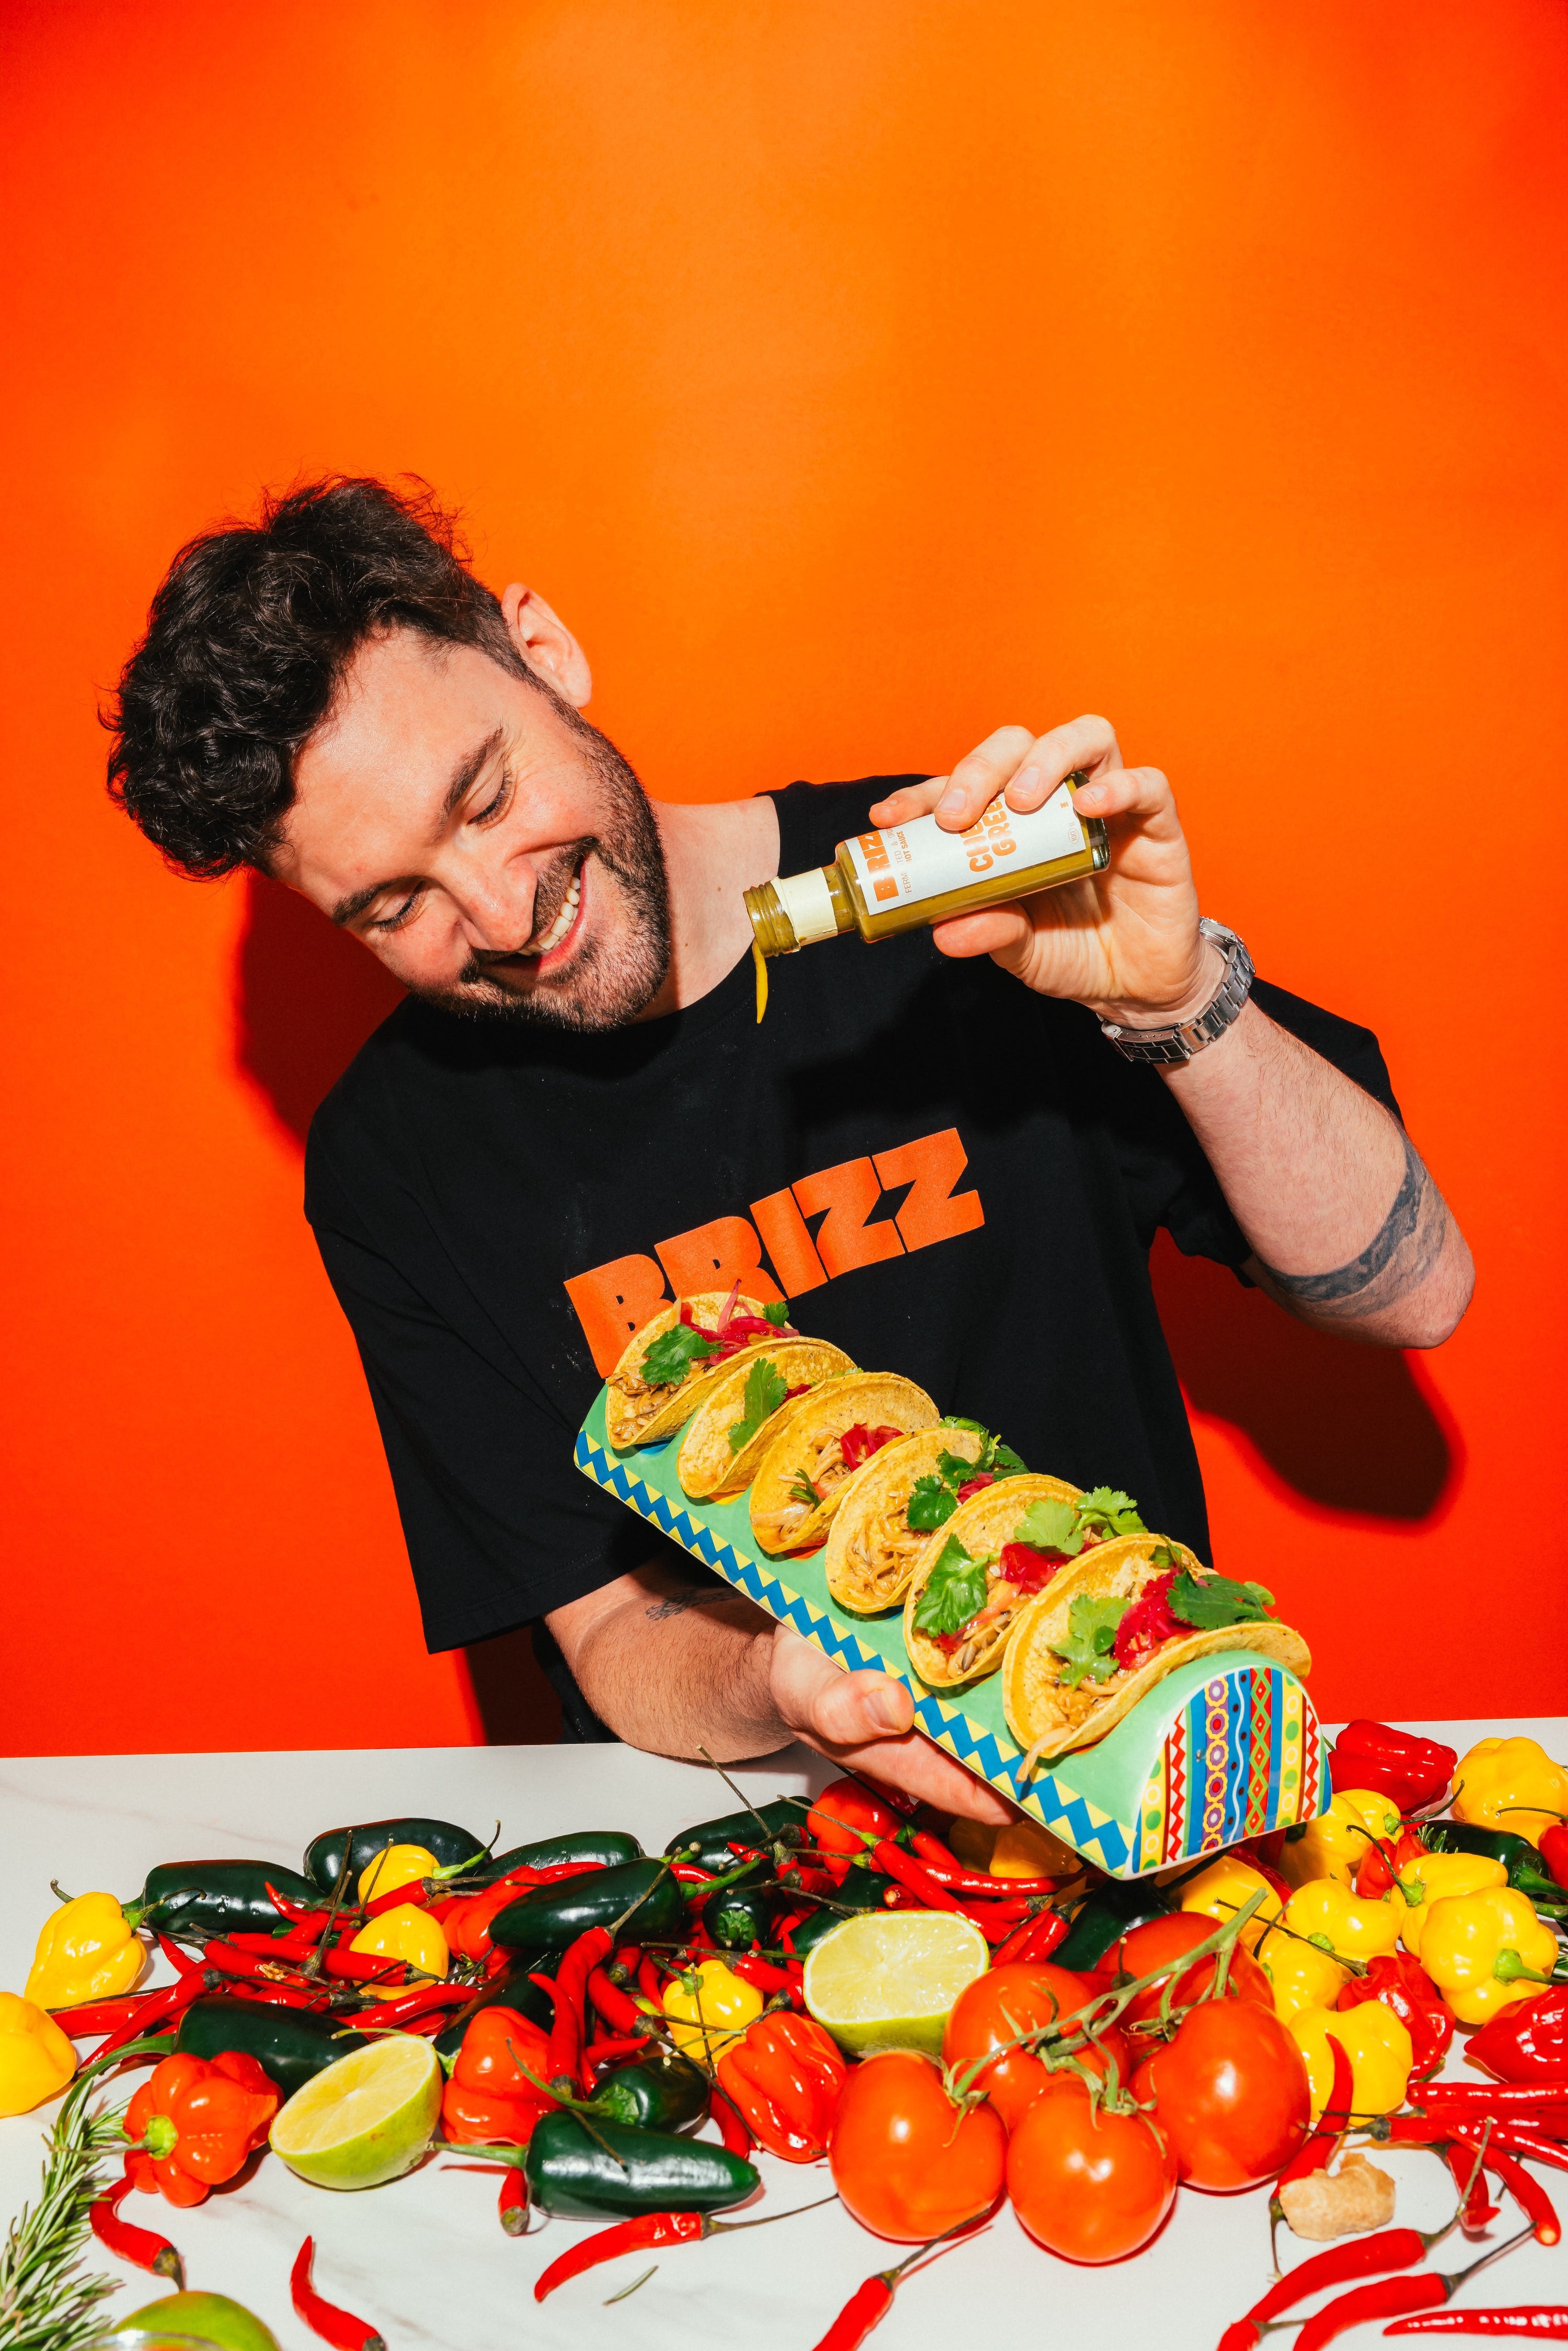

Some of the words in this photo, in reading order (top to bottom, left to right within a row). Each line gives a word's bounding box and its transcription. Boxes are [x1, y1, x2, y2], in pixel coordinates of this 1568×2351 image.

[896, 831, 908, 849] SAUCE
[982, 798, 1017, 856] GREE
[894, 850, 912, 893] FERMTED
[563, 1127, 985, 1379] BRIZZ
